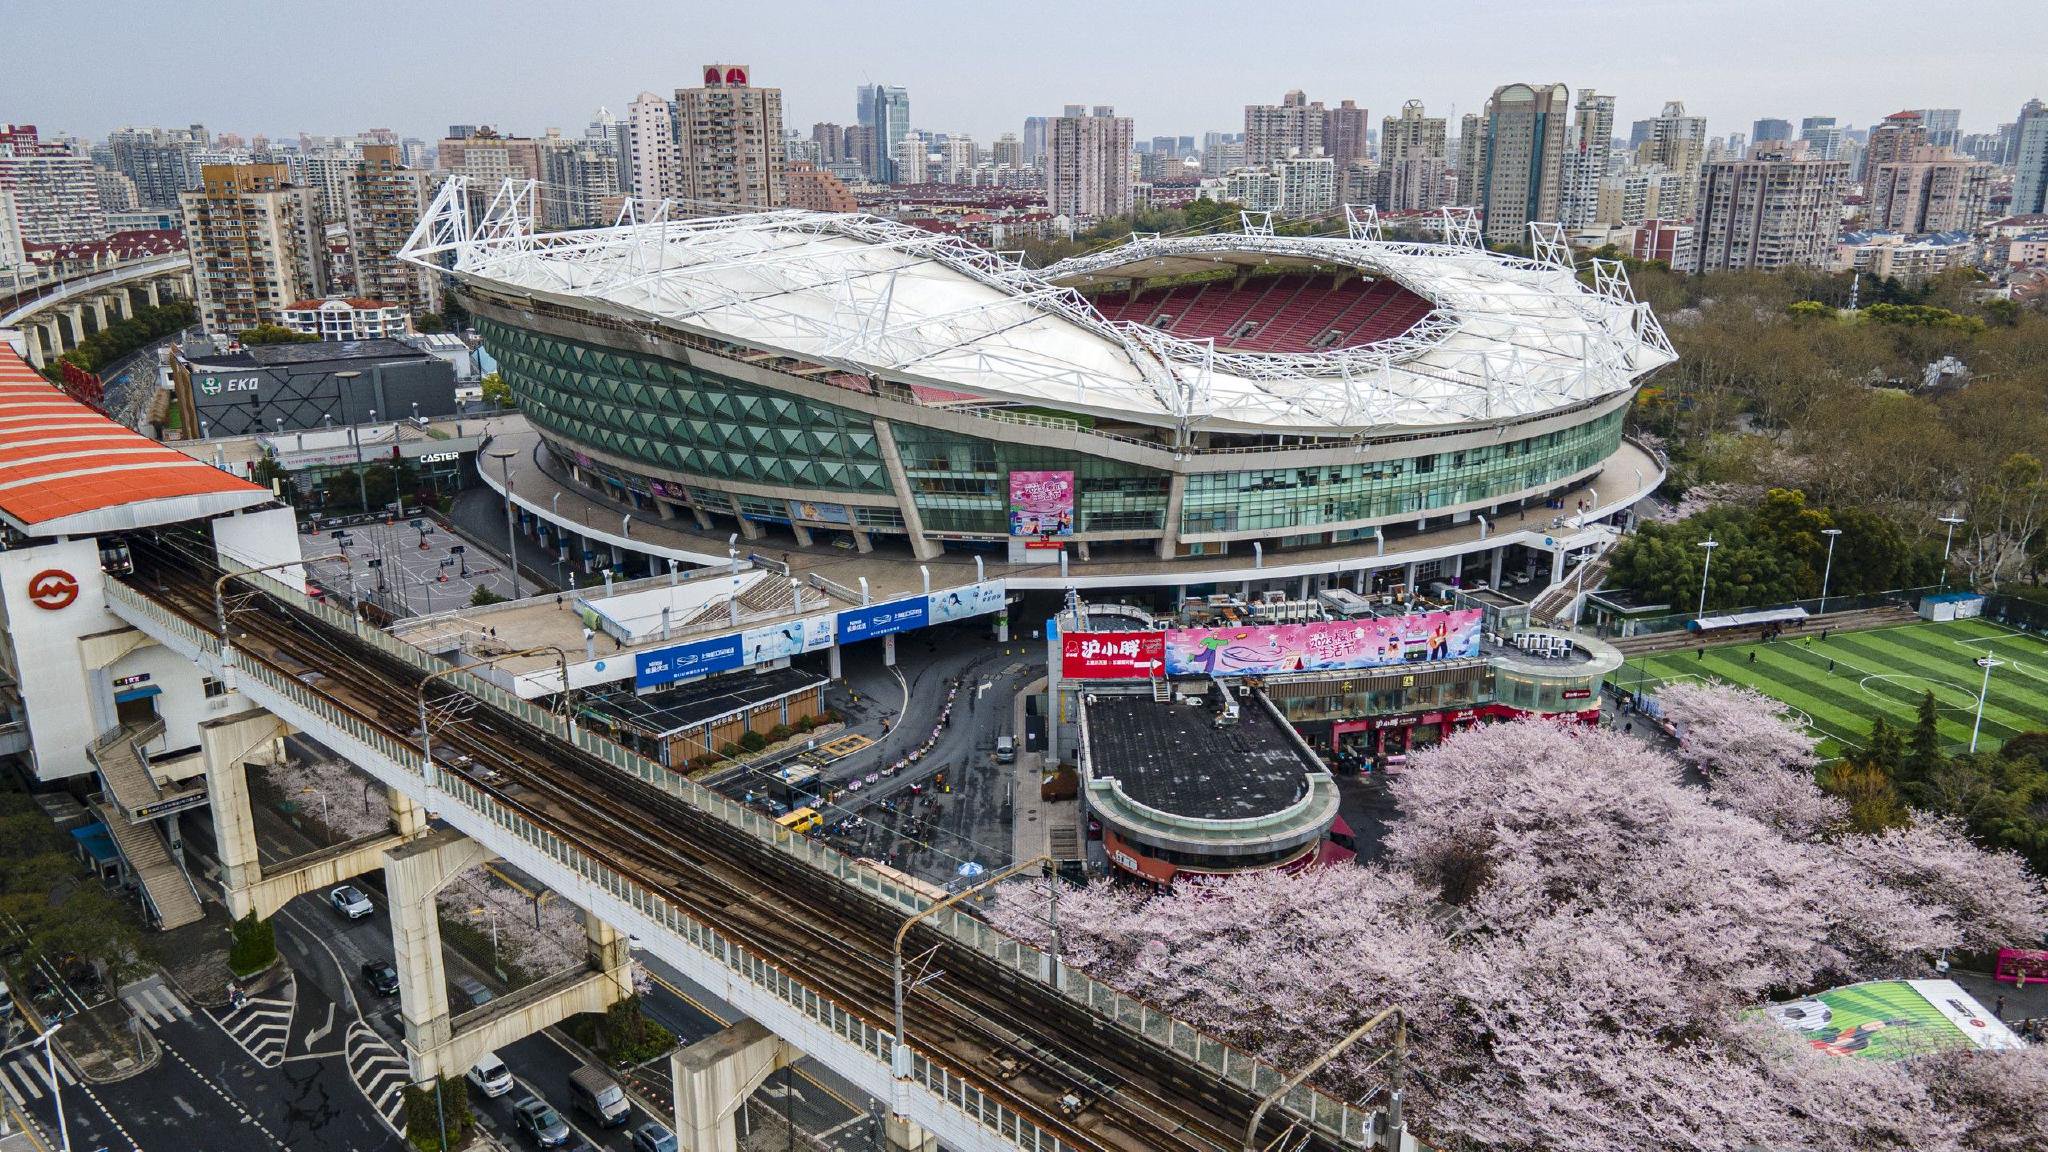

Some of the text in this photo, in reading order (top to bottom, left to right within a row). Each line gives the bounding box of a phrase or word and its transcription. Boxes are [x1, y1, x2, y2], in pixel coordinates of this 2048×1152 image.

[227, 378, 259, 392] EKO
[420, 452, 459, 463] CASTER
[1081, 639, 1140, 658] 沪小胖
[1319, 641, 1355, 660] 生活节
